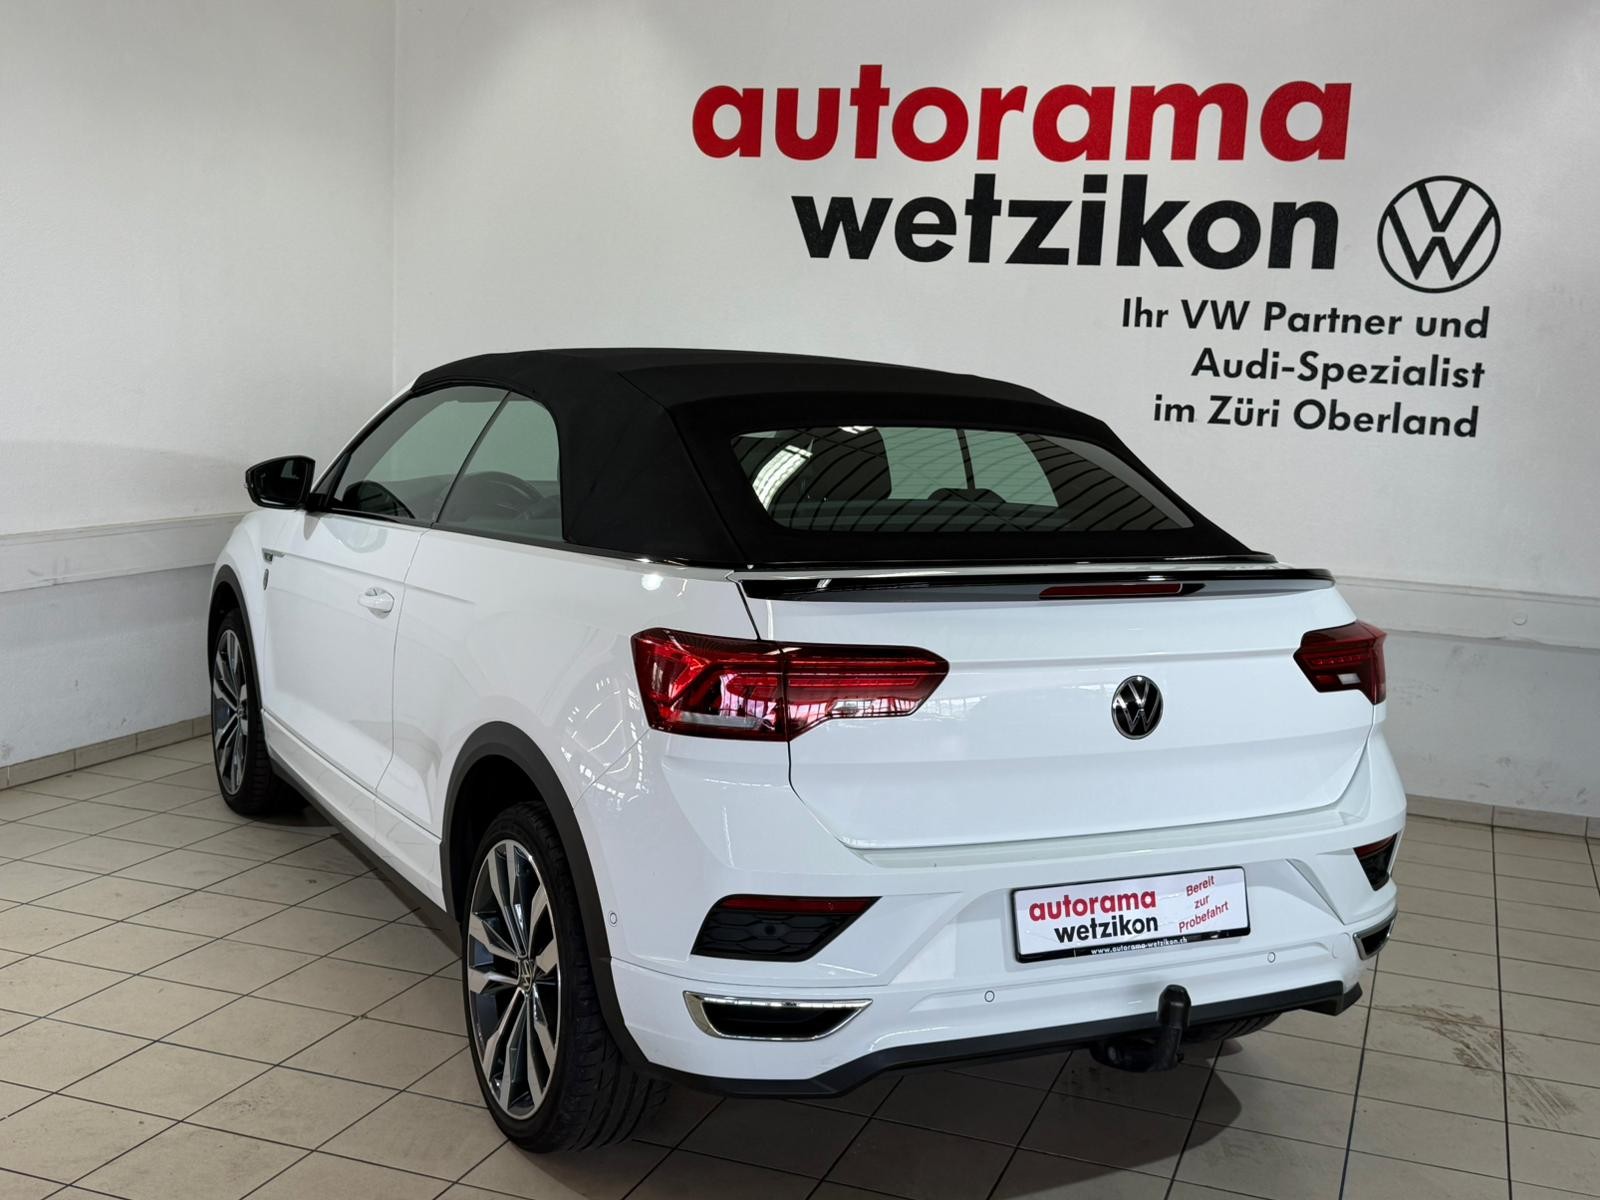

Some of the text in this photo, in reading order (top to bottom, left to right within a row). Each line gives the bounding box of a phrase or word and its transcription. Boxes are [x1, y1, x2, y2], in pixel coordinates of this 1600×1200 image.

[693, 64, 1352, 162] autorama
[791, 174, 1339, 270] wetzikon
[1122, 297, 1490, 339] Ihr VW Partner und
[1190, 347, 1486, 390] Audi-Spezialist
[1153, 393, 1479, 438] im Züri Oberland
[1186, 875, 1215, 897] Bereit
[1194, 895, 1210, 909] zur
[1029, 890, 1157, 922] autorama
[1178, 900, 1229, 933] Probefahrt
[1053, 914, 1159, 943] wetzikon
[1090, 936, 1188, 955] www.autorama-wetzikon.ch
